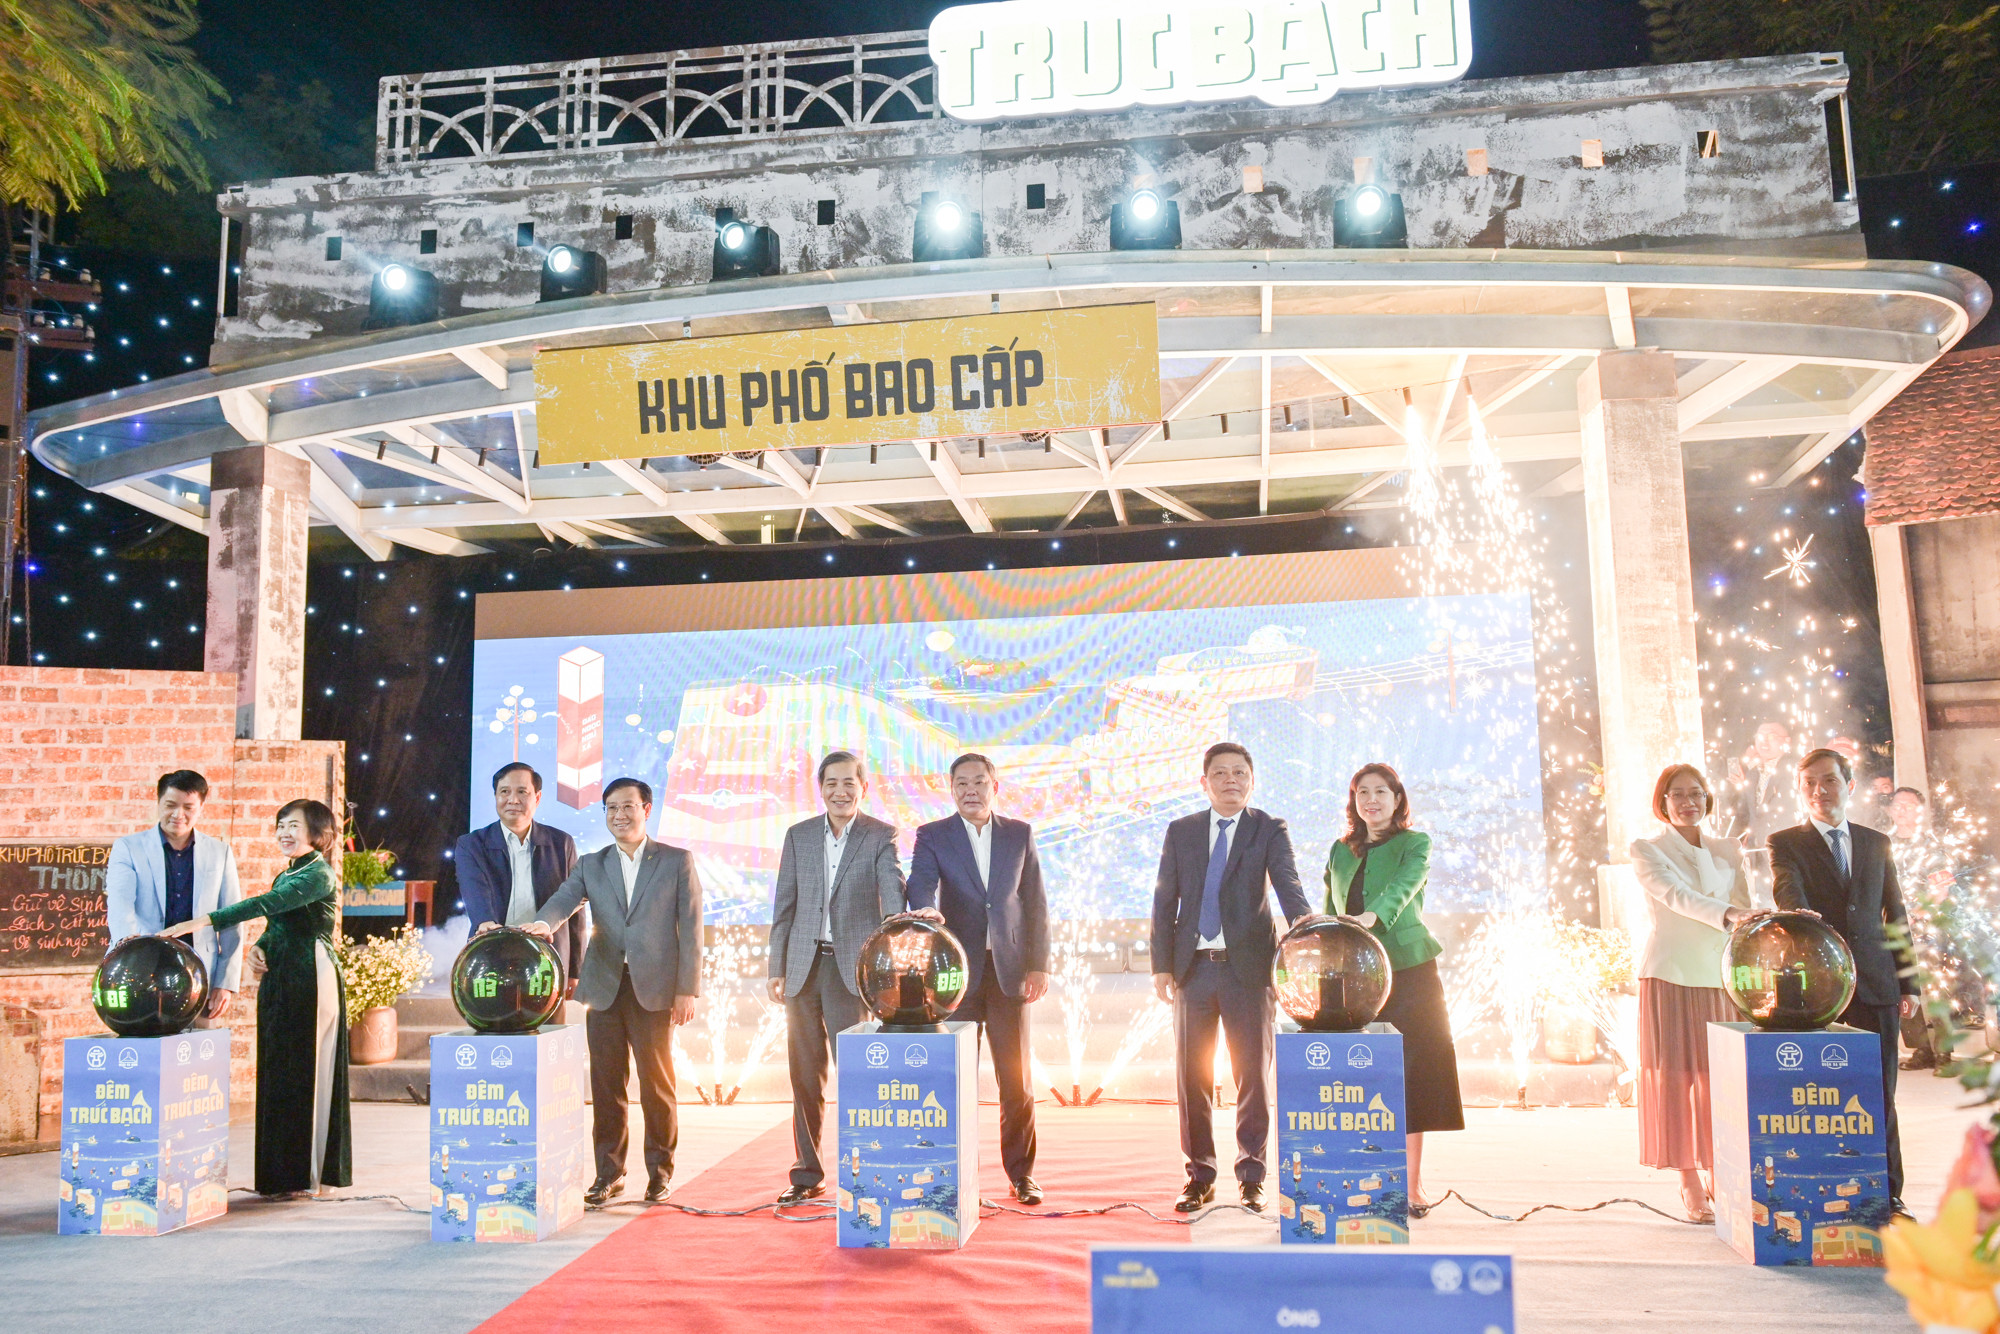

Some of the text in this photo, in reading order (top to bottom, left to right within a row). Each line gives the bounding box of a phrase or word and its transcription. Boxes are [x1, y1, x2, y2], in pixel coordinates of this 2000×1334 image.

[638, 336, 1044, 434] KHU PHỐ BAO CẤP
[0, 847, 26, 863] KHU
[28, 864, 109, 891] THÔN
[95, 1079, 130, 1100] ĐÊM
[465, 1079, 504, 1101] ĐÊM
[877, 1079, 920, 1101] ĐÊM
[1318, 1080, 1365, 1103] ĐÊM
[1791, 1081, 1840, 1106] ĐÊM
[110, 1104, 152, 1126] BẠCH
[483, 1105, 530, 1129] BẠCH
[897, 1106, 948, 1130] BẠCH
[1287, 1104, 1395, 1134] TRÚC BẠCH
[1758, 1106, 1812, 1134] TRÚC
[1815, 1112, 1874, 1138] BẠCH
